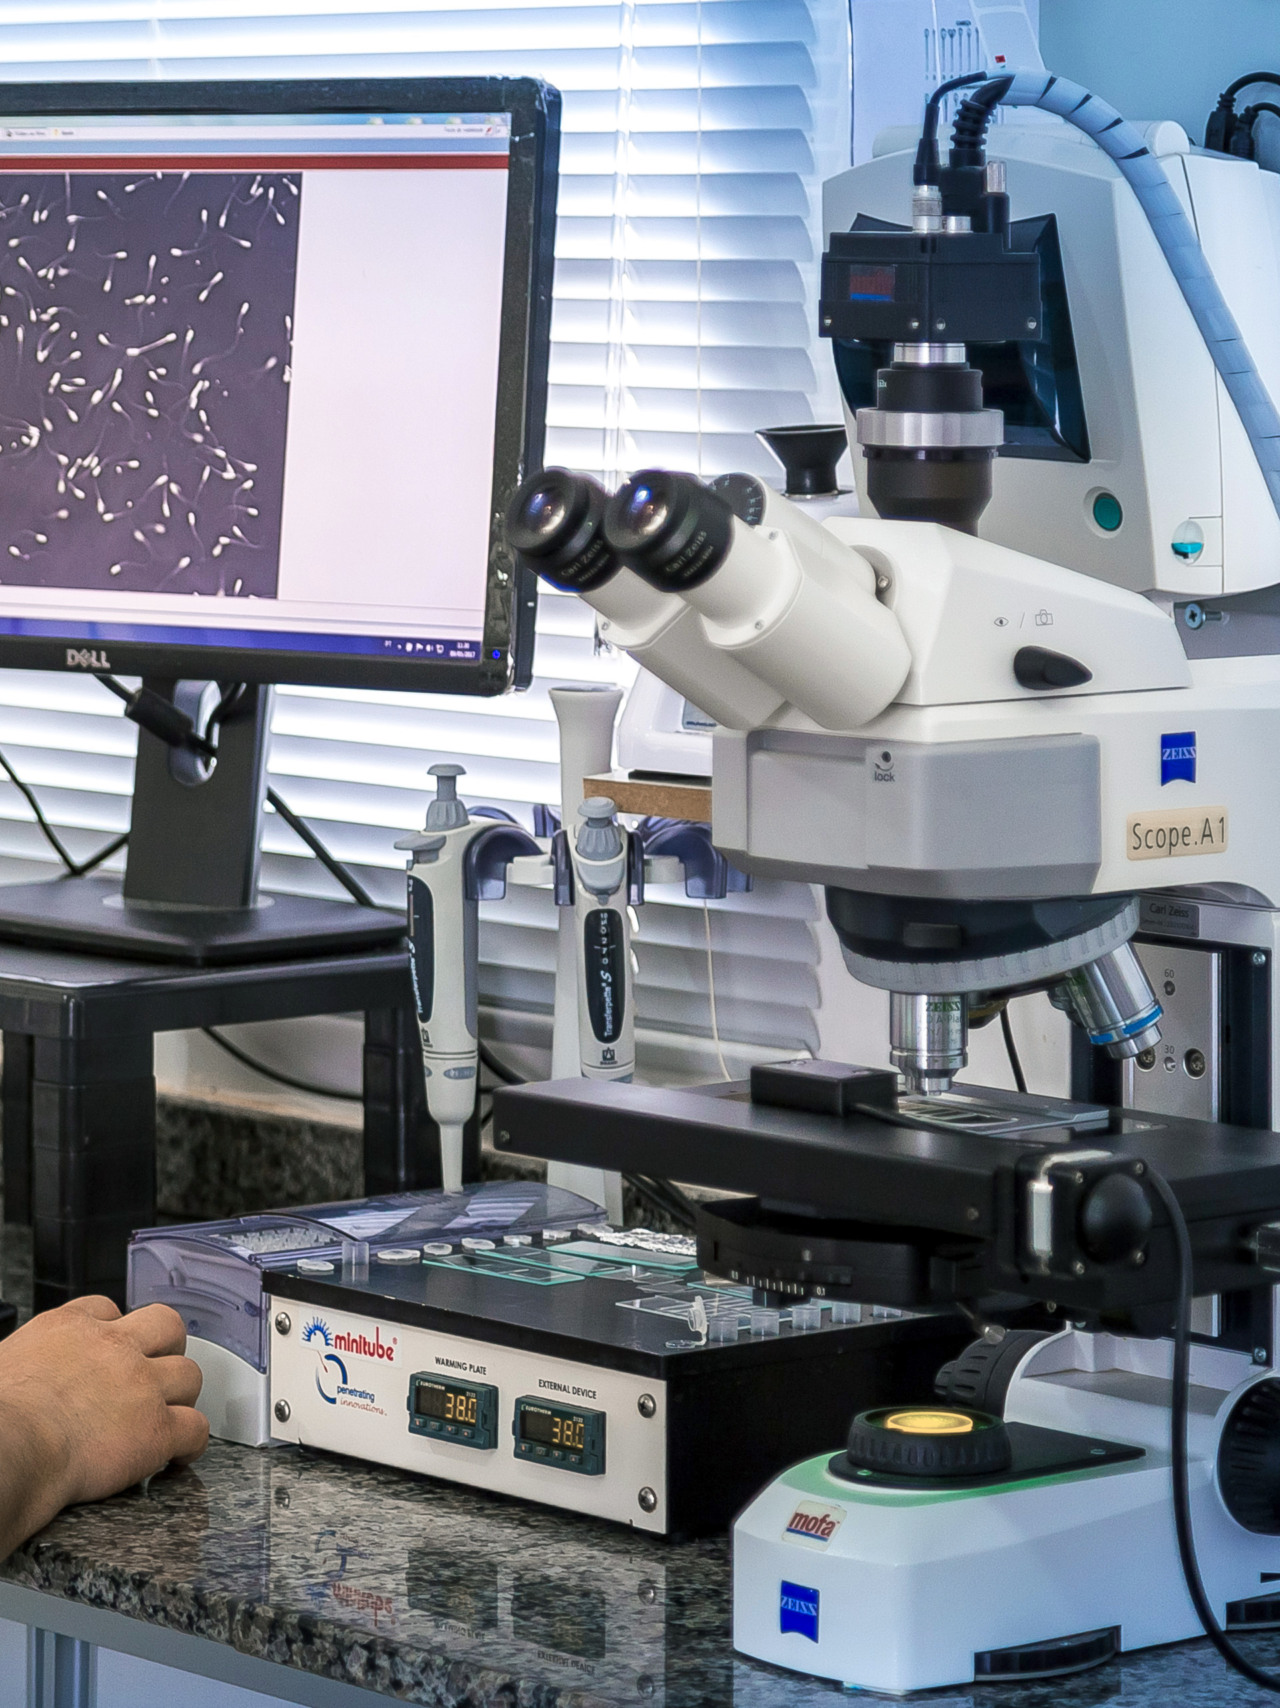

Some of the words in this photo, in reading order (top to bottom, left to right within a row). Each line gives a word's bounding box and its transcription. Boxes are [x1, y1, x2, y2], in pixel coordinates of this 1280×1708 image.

[66, 648, 111, 669] DELL
[1162, 746, 1196, 761] ZEISS
[874, 770, 896, 782] lock
[1149, 902, 1167, 914] Carl
[1168, 905, 1190, 918] Zeiss
[600, 969, 612, 983] S
[1164, 968, 1175, 979] 60
[926, 1001, 961, 1013] ZEISS
[1164, 1044, 1175, 1055] 30
[435, 1356, 468, 1371] WARMING
[469, 1363, 487, 1376] PLATE
[337, 1385, 375, 1404] penetrating
[538, 1379, 571, 1394] EXTERNAL
[572, 1386, 597, 1399] DEVICE
[445, 1393, 477, 1424] 38.0
[552, 1417, 584, 1449] 38.0
[788, 1512, 838, 1538] mofa
[781, 1595, 818, 1617] ZEISS
